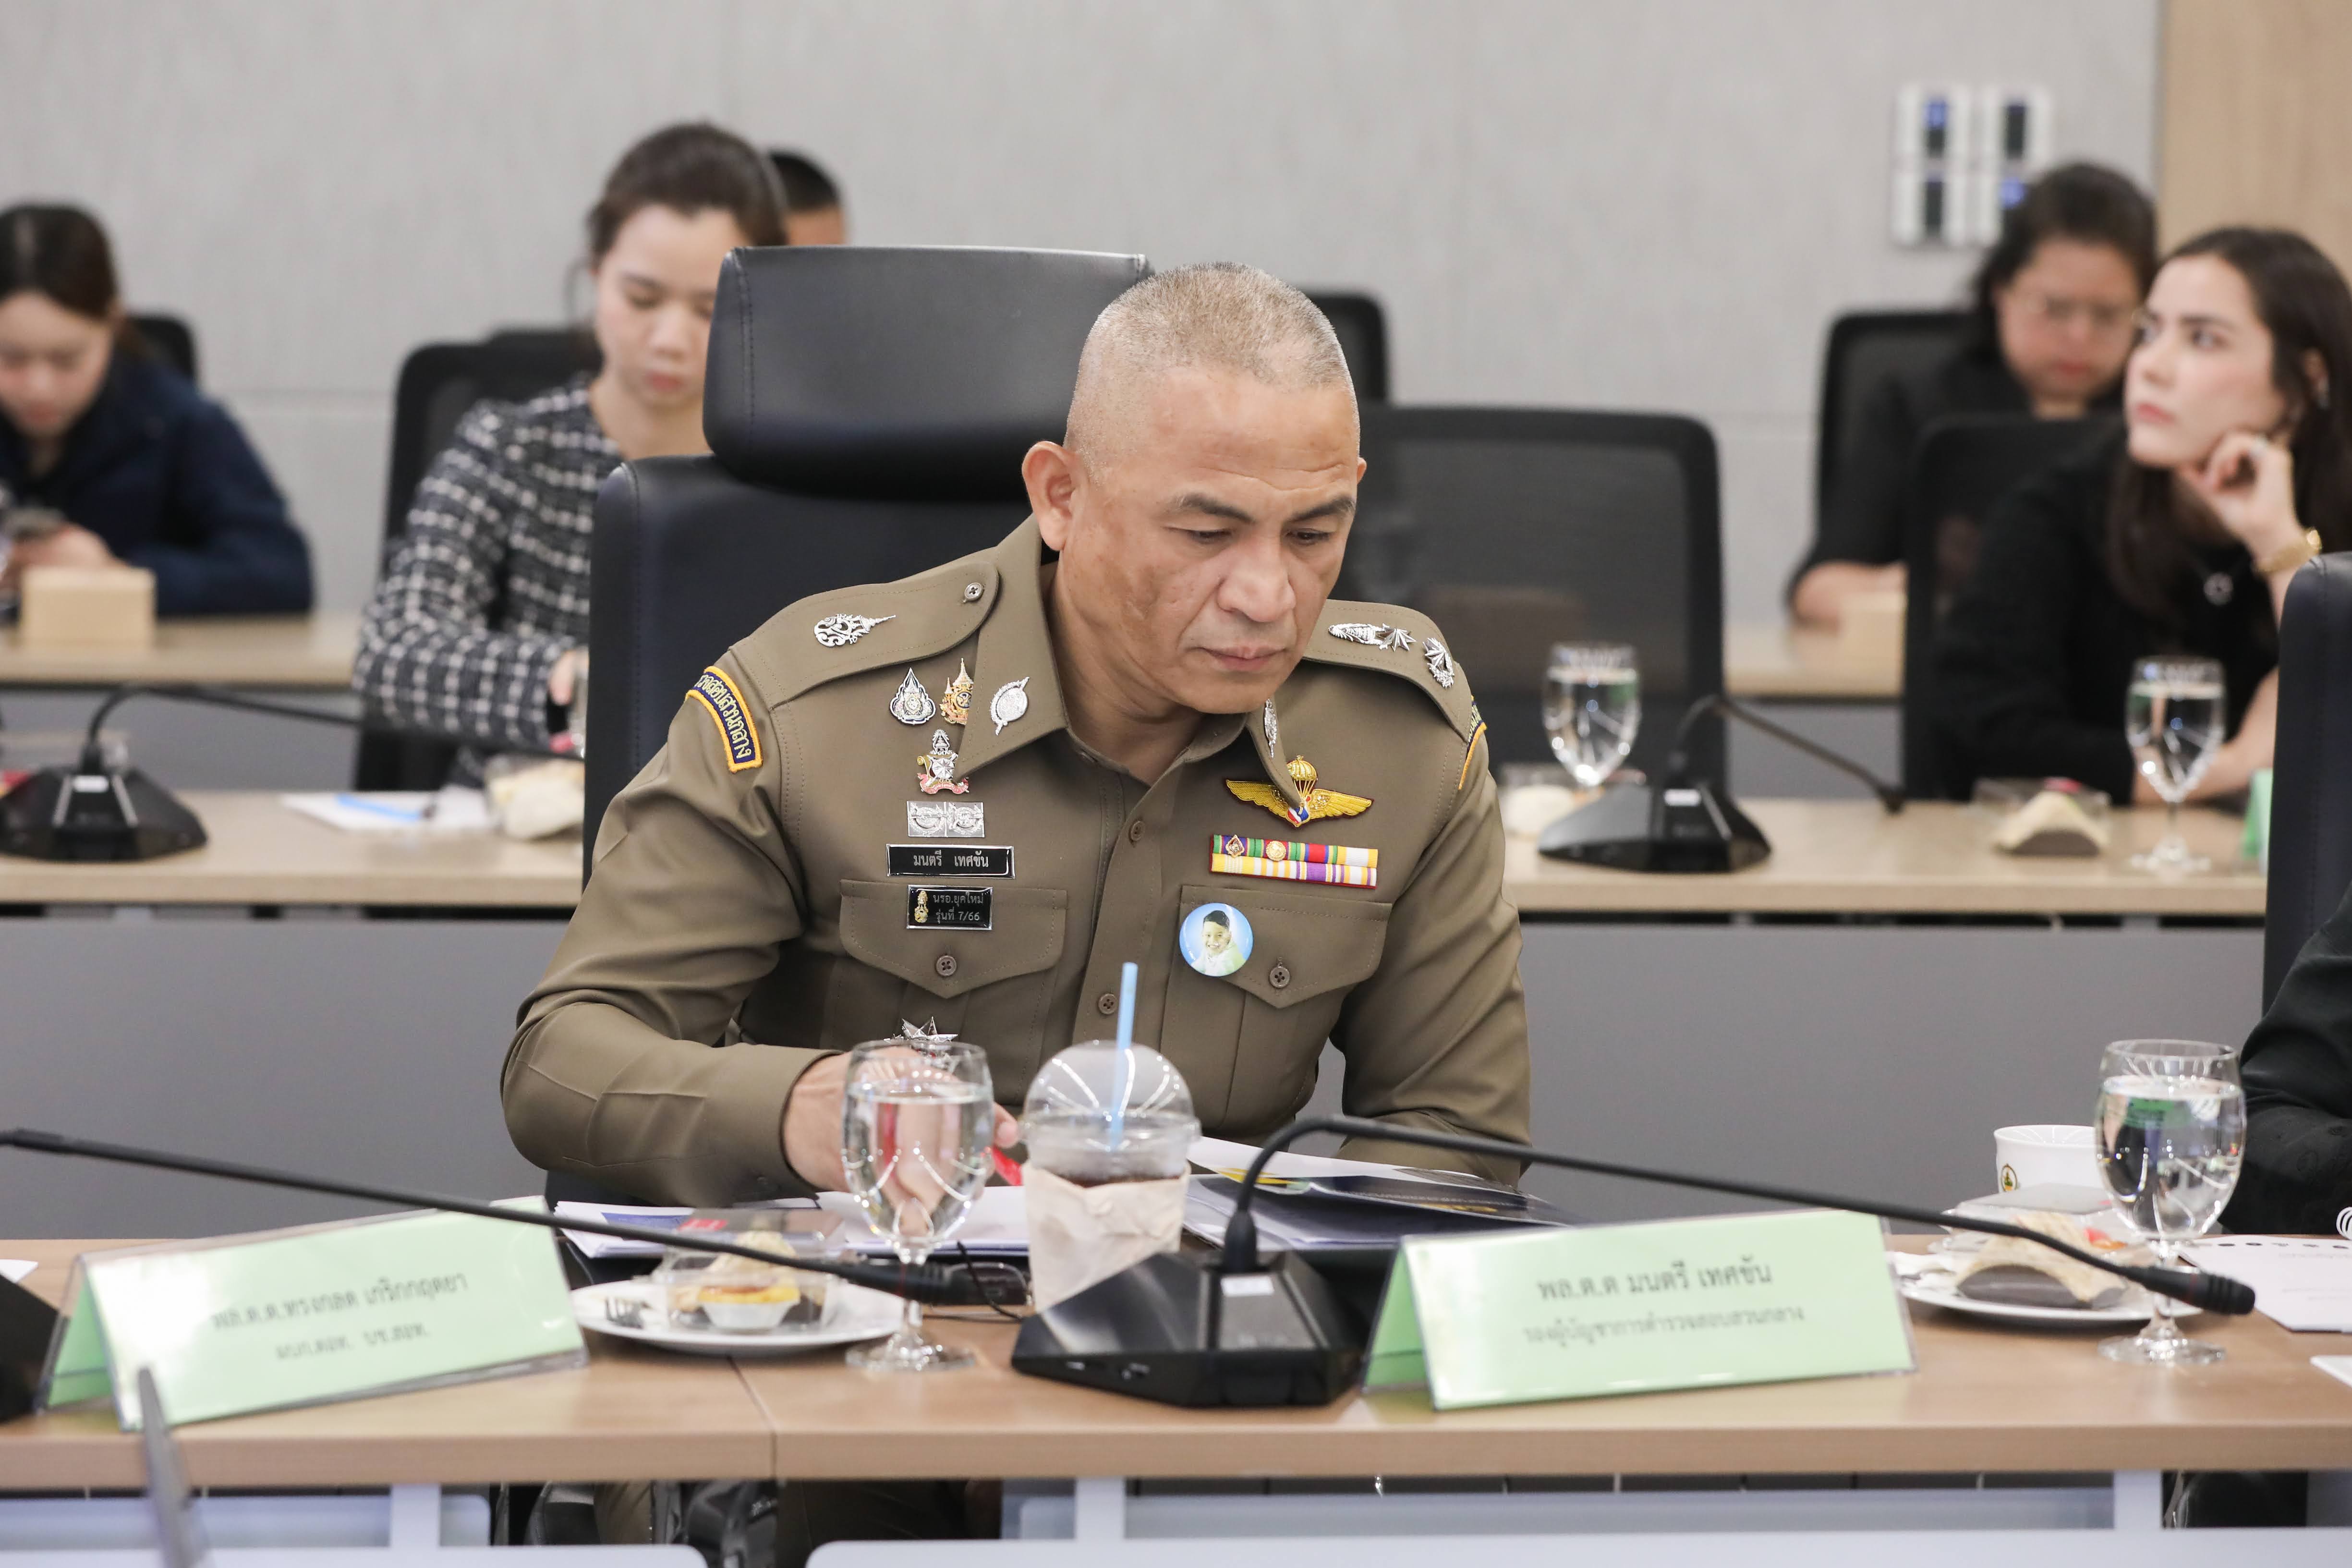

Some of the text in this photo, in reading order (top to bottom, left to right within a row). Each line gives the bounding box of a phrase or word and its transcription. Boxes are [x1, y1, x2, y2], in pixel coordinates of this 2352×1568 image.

[913, 850, 989, 867] มนตรี เทศขัน
[933, 891, 983, 907] นรอ.ยุคใหม่
[936, 906, 980, 924] รุ่นที่ 7/66
[1628, 1260, 1689, 1294] มนตรี
